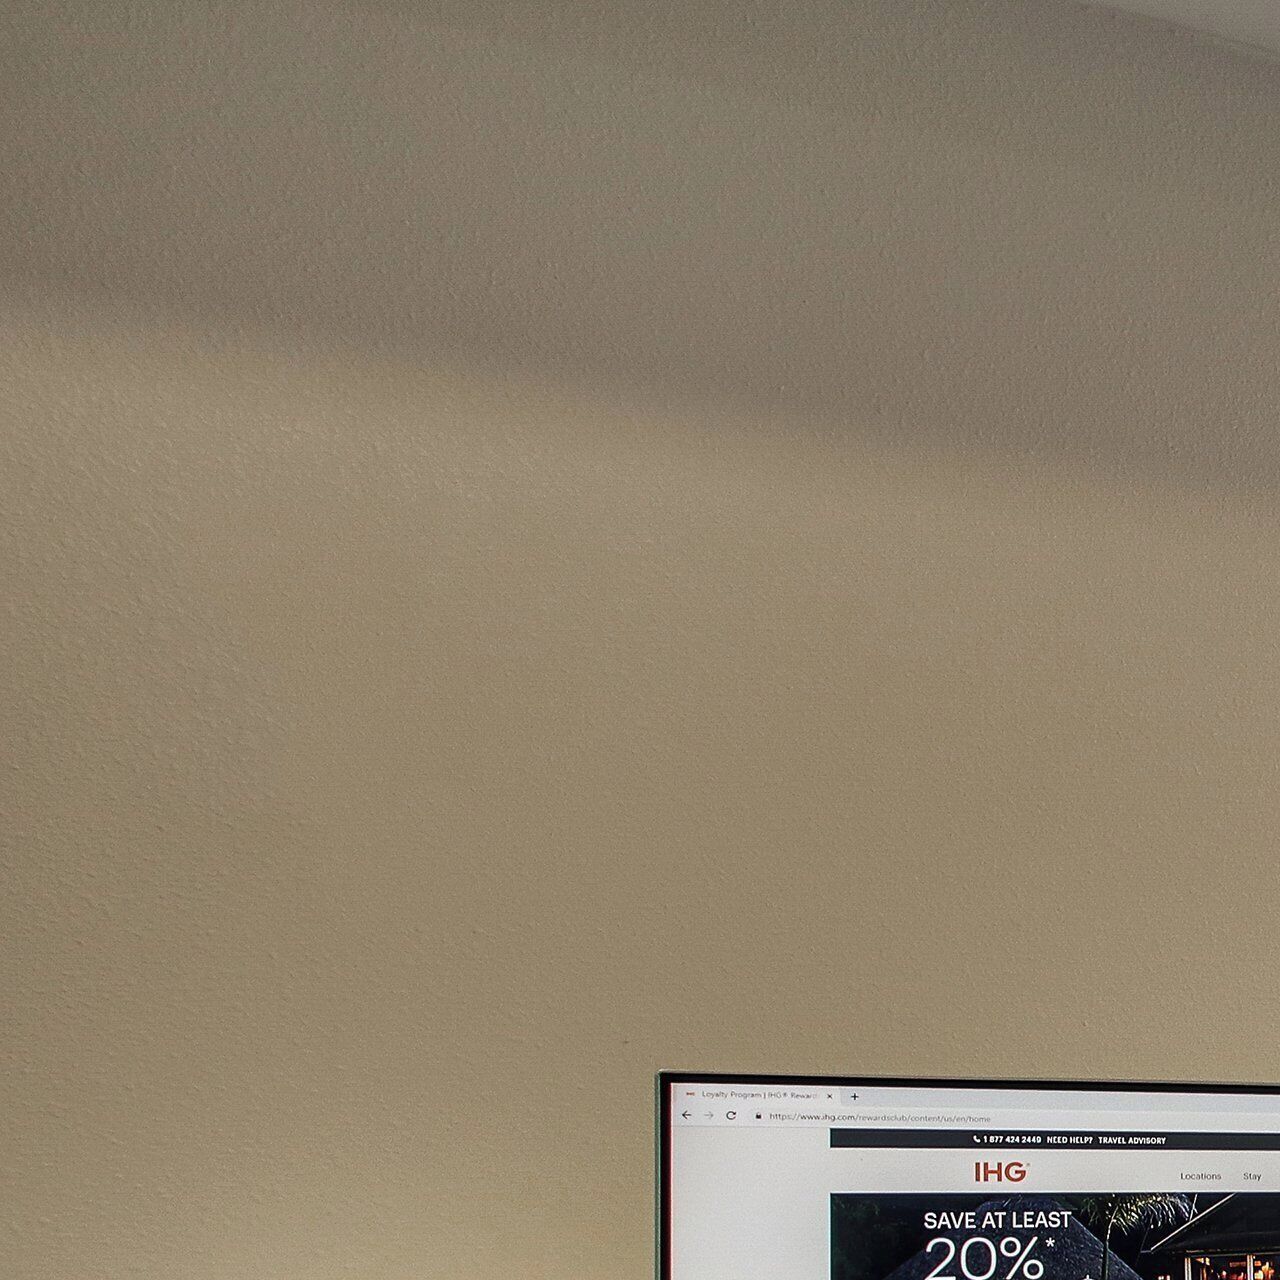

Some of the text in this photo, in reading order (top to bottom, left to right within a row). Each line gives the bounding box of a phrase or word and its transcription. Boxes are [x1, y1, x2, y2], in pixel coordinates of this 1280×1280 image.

[702, 1091, 727, 1102] Loyalty
[730, 1091, 762, 1102] Program
[990, 1135, 1003, 1144] 877
[1005, 1135, 1020, 1144] 424
[1046, 1136, 1093, 1145] NEED HELP?
[1098, 1136, 1166, 1145] TRAVEL ADVISORY
[975, 1162, 1026, 1182] IHG
[1180, 1172, 1222, 1180] Locations
[1243, 1172, 1262, 1181] Stay
[924, 1211, 1072, 1230] SAVE AT LEAST
